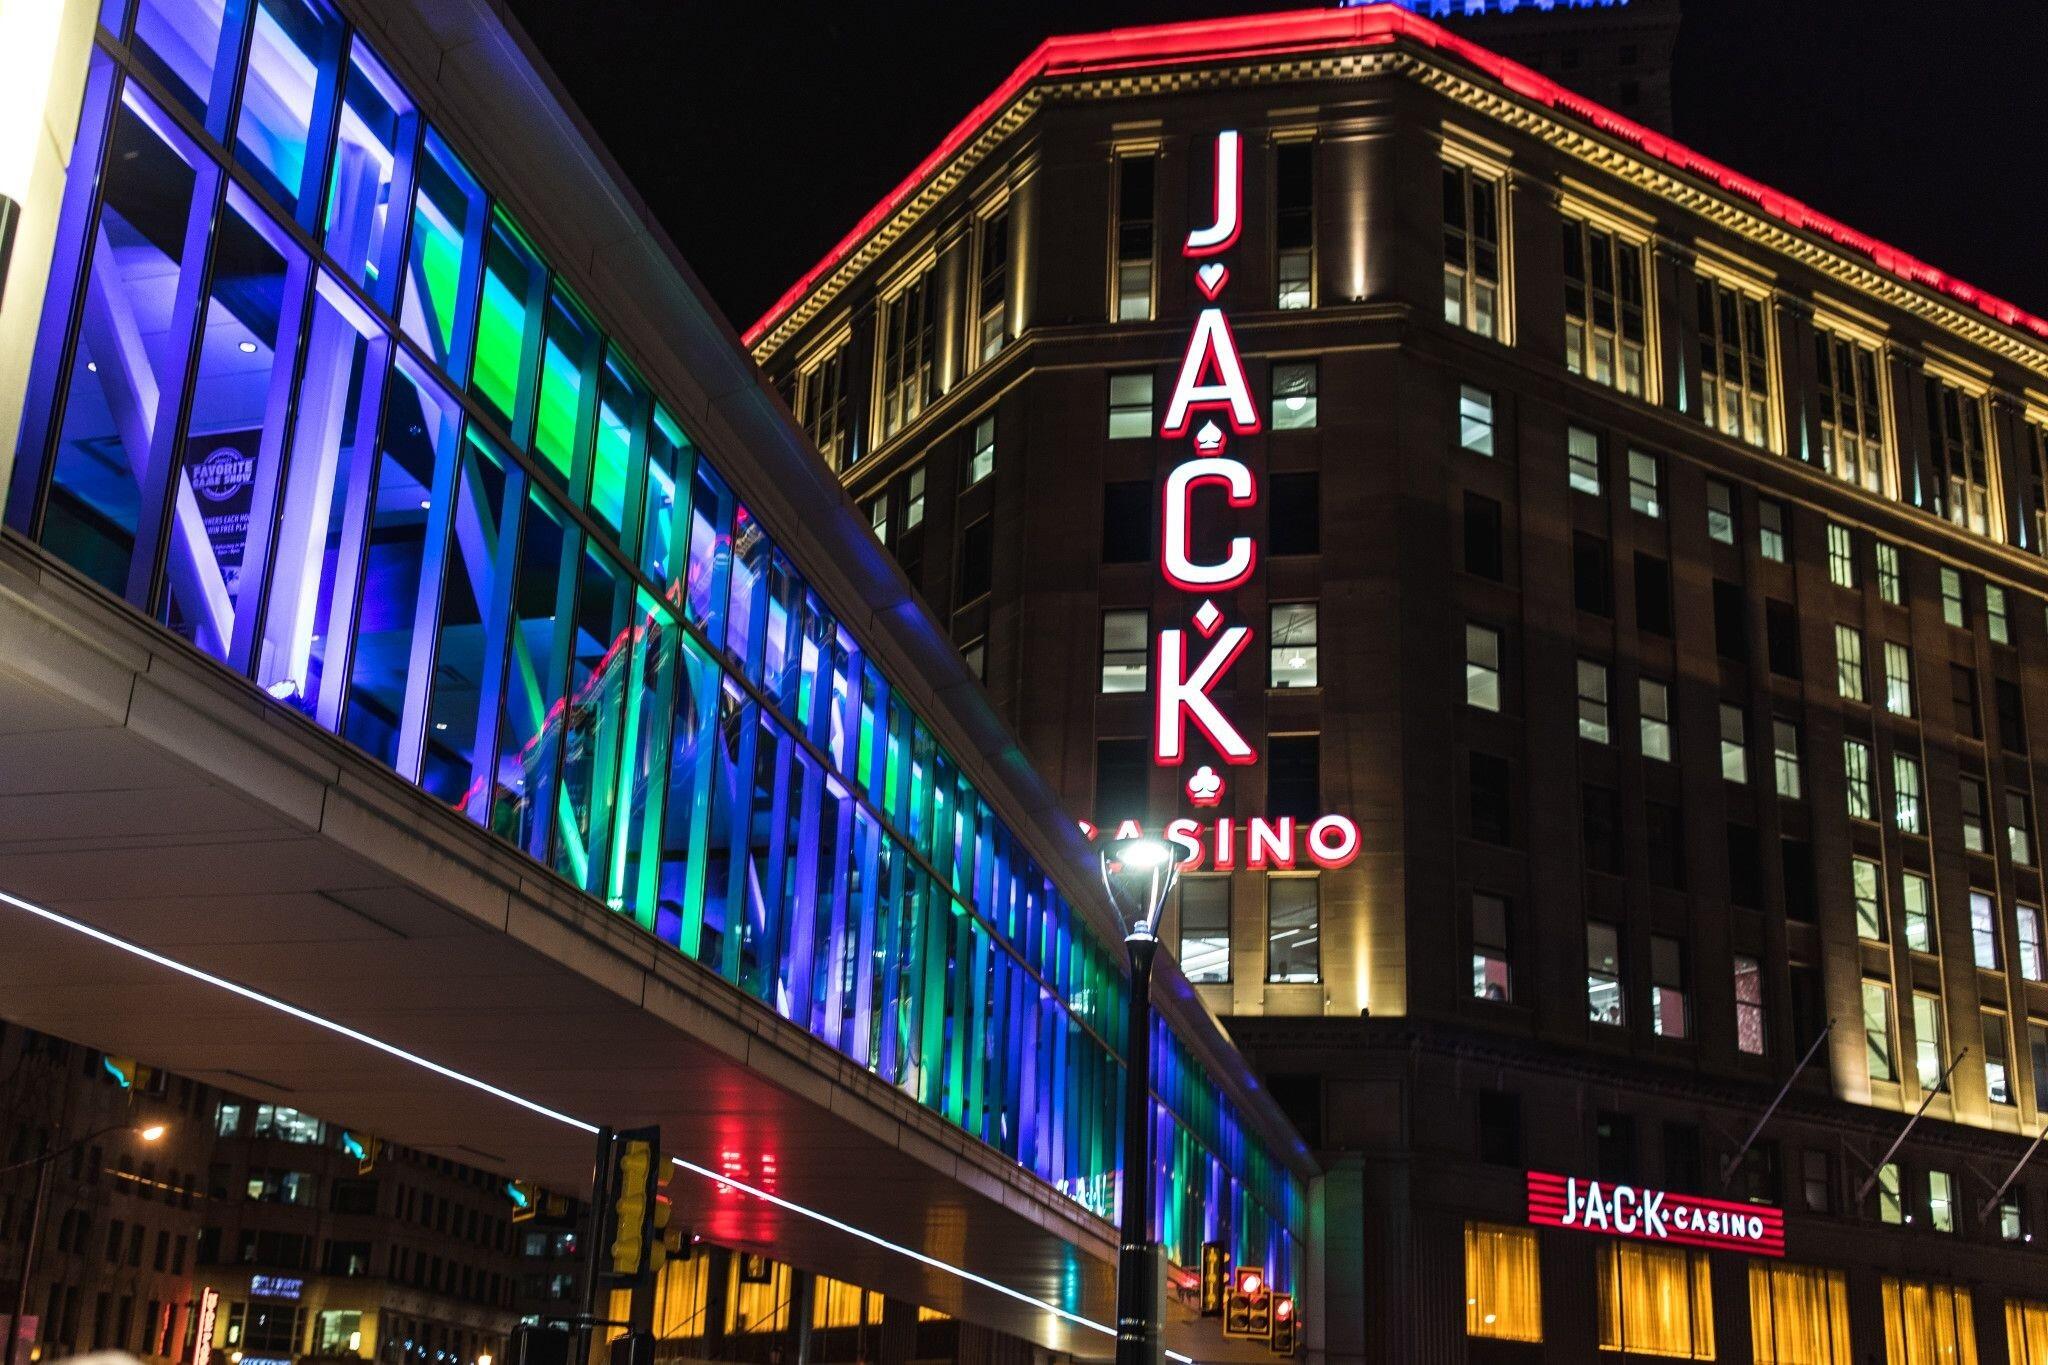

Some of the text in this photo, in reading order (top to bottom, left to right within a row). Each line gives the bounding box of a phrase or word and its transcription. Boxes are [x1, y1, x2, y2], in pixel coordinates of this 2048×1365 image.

[1156, 130, 1260, 764] JACK
[193, 459, 254, 478] FAVORITE
[192, 472, 252, 489] GAME SHOW
[235, 522, 248, 532] PLA
[1674, 1206, 1764, 1240] CASINO
